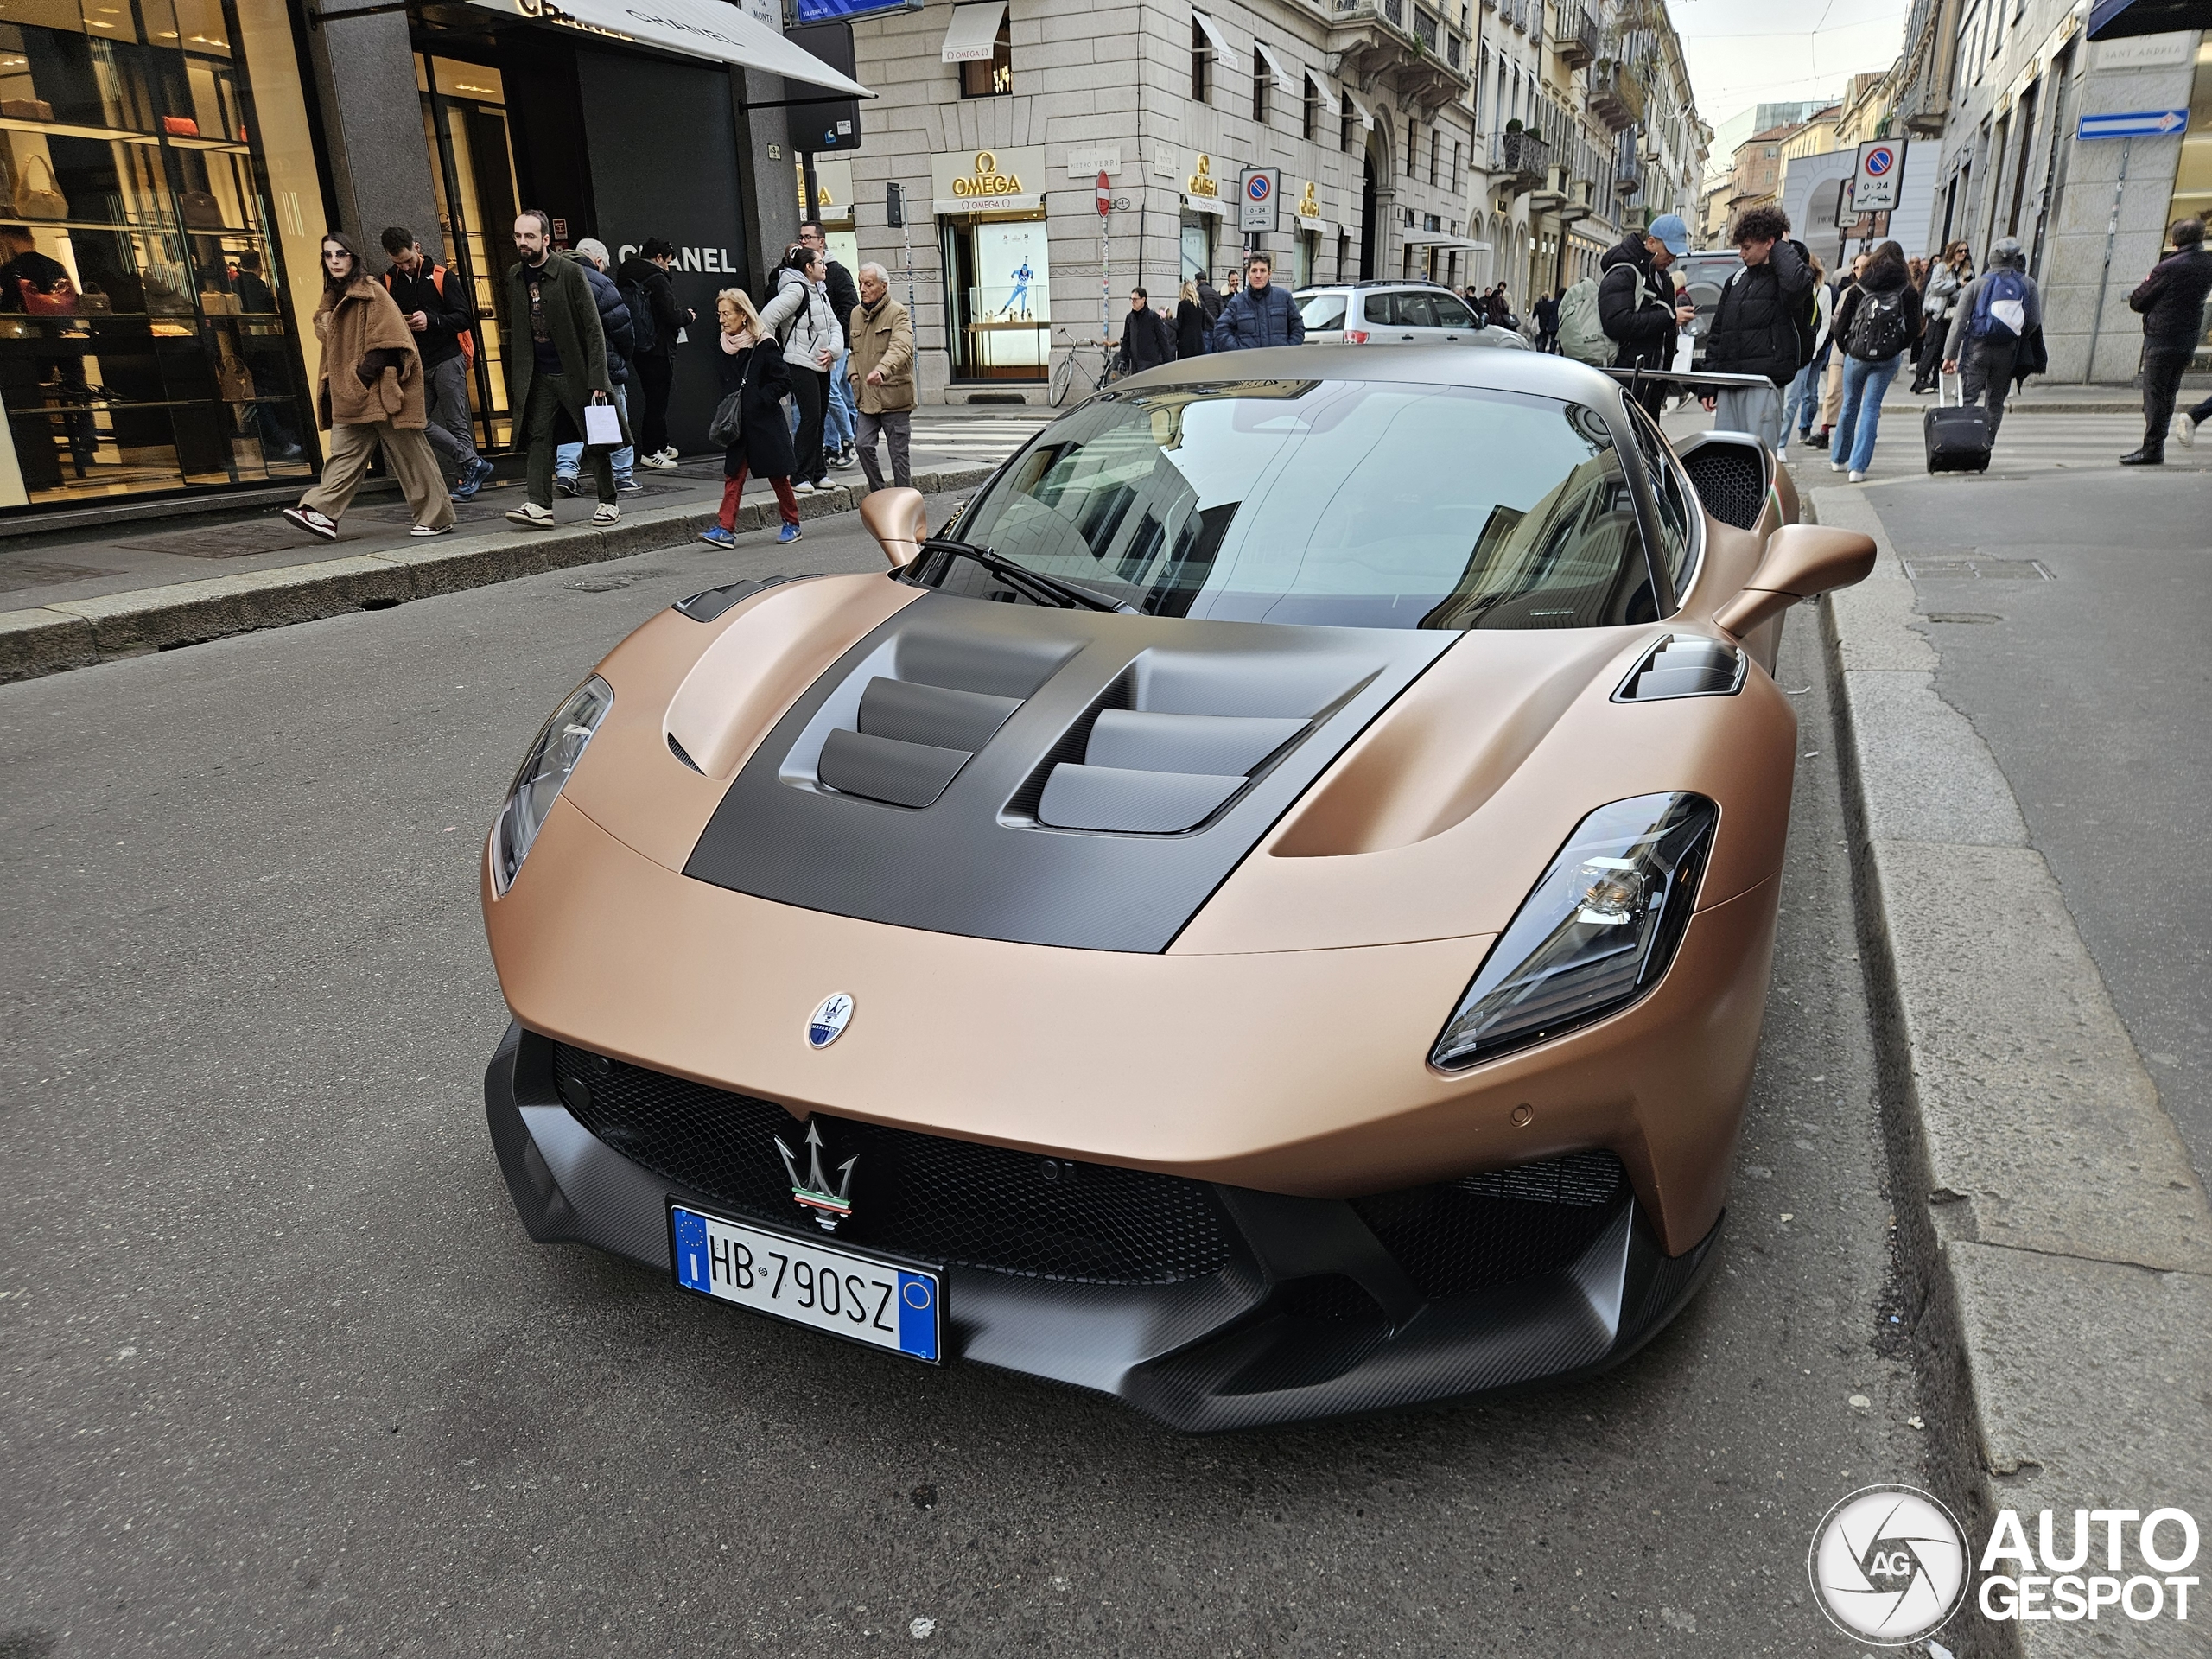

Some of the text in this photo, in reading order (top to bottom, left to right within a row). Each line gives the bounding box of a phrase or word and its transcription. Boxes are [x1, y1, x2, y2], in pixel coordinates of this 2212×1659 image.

[753, 10, 773, 24] MONTE
[625, 9, 746, 48] CHANEL
[956, 49, 980, 59] OMEGA
[1093, 159, 1118, 168] VERRI
[952, 173, 1023, 197] OMEGA
[1187, 174, 1219, 198] OMEGA
[971, 200, 1000, 210] OMEGA
[618, 244, 736, 273] CANEL
[812, 1024, 838, 1033] MASERATI
